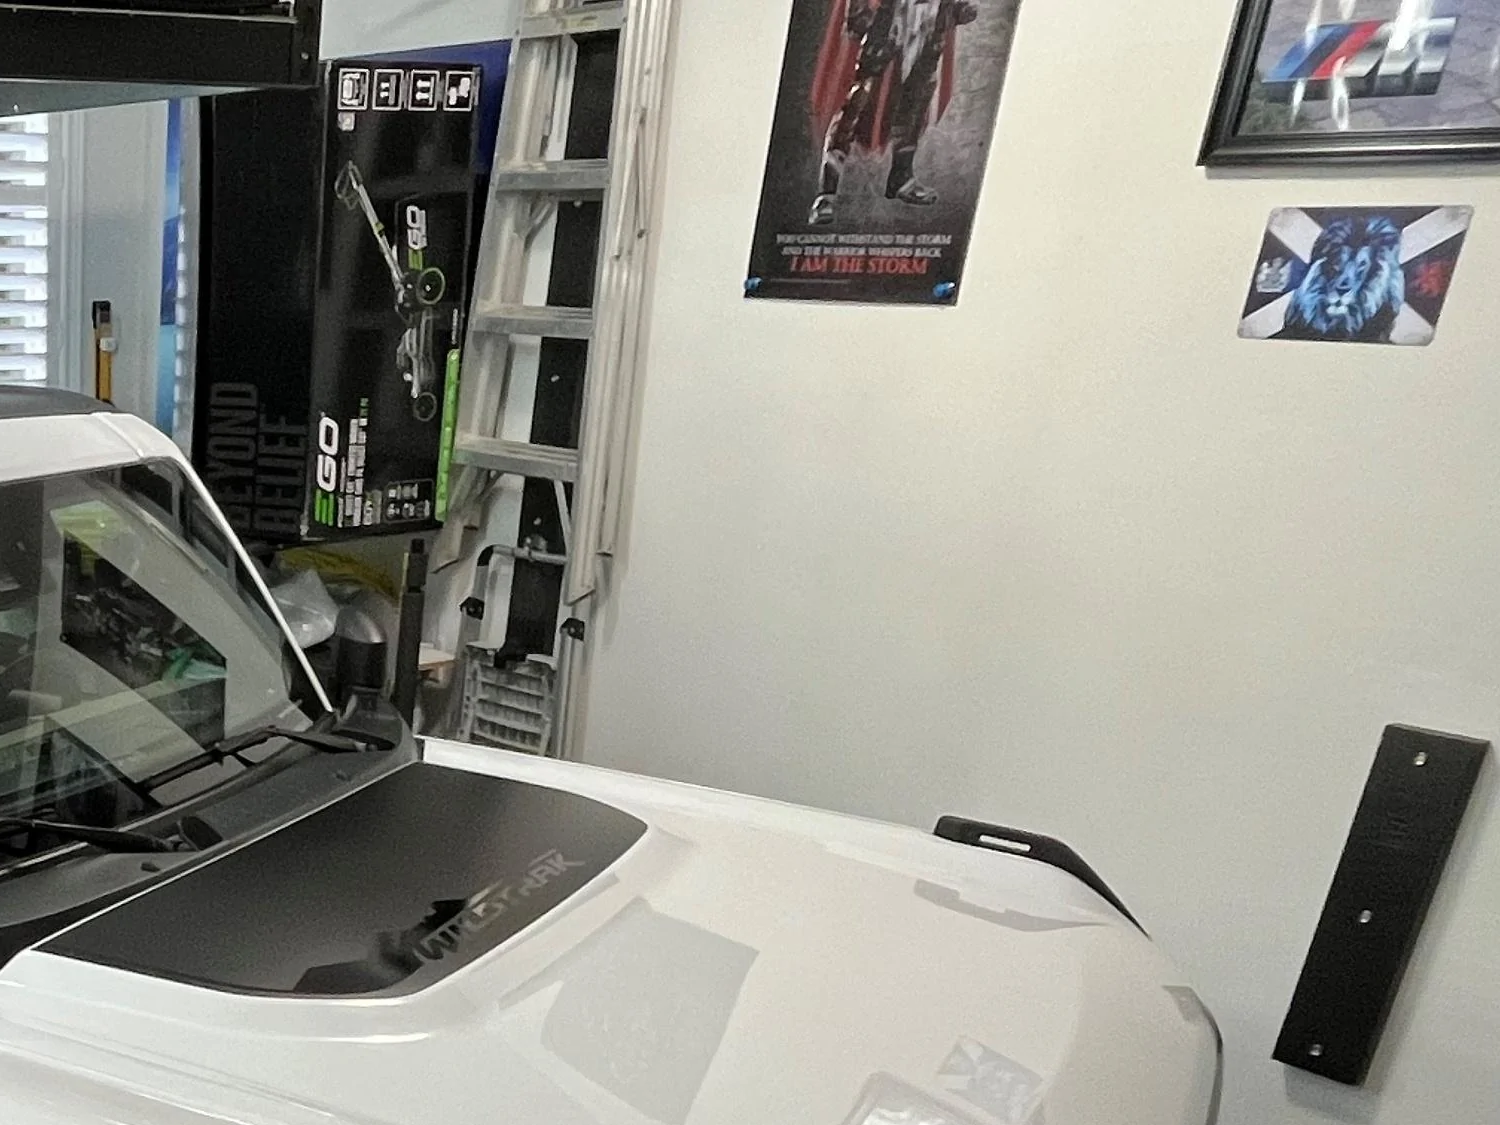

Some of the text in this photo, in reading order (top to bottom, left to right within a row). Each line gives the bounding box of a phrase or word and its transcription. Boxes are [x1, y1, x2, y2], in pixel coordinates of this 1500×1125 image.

[790, 256, 928, 275] I AM THE STORM
[206, 382, 259, 528] BEYOND
[254, 413, 306, 534] BELIEF
[314, 417, 340, 528] EGO
